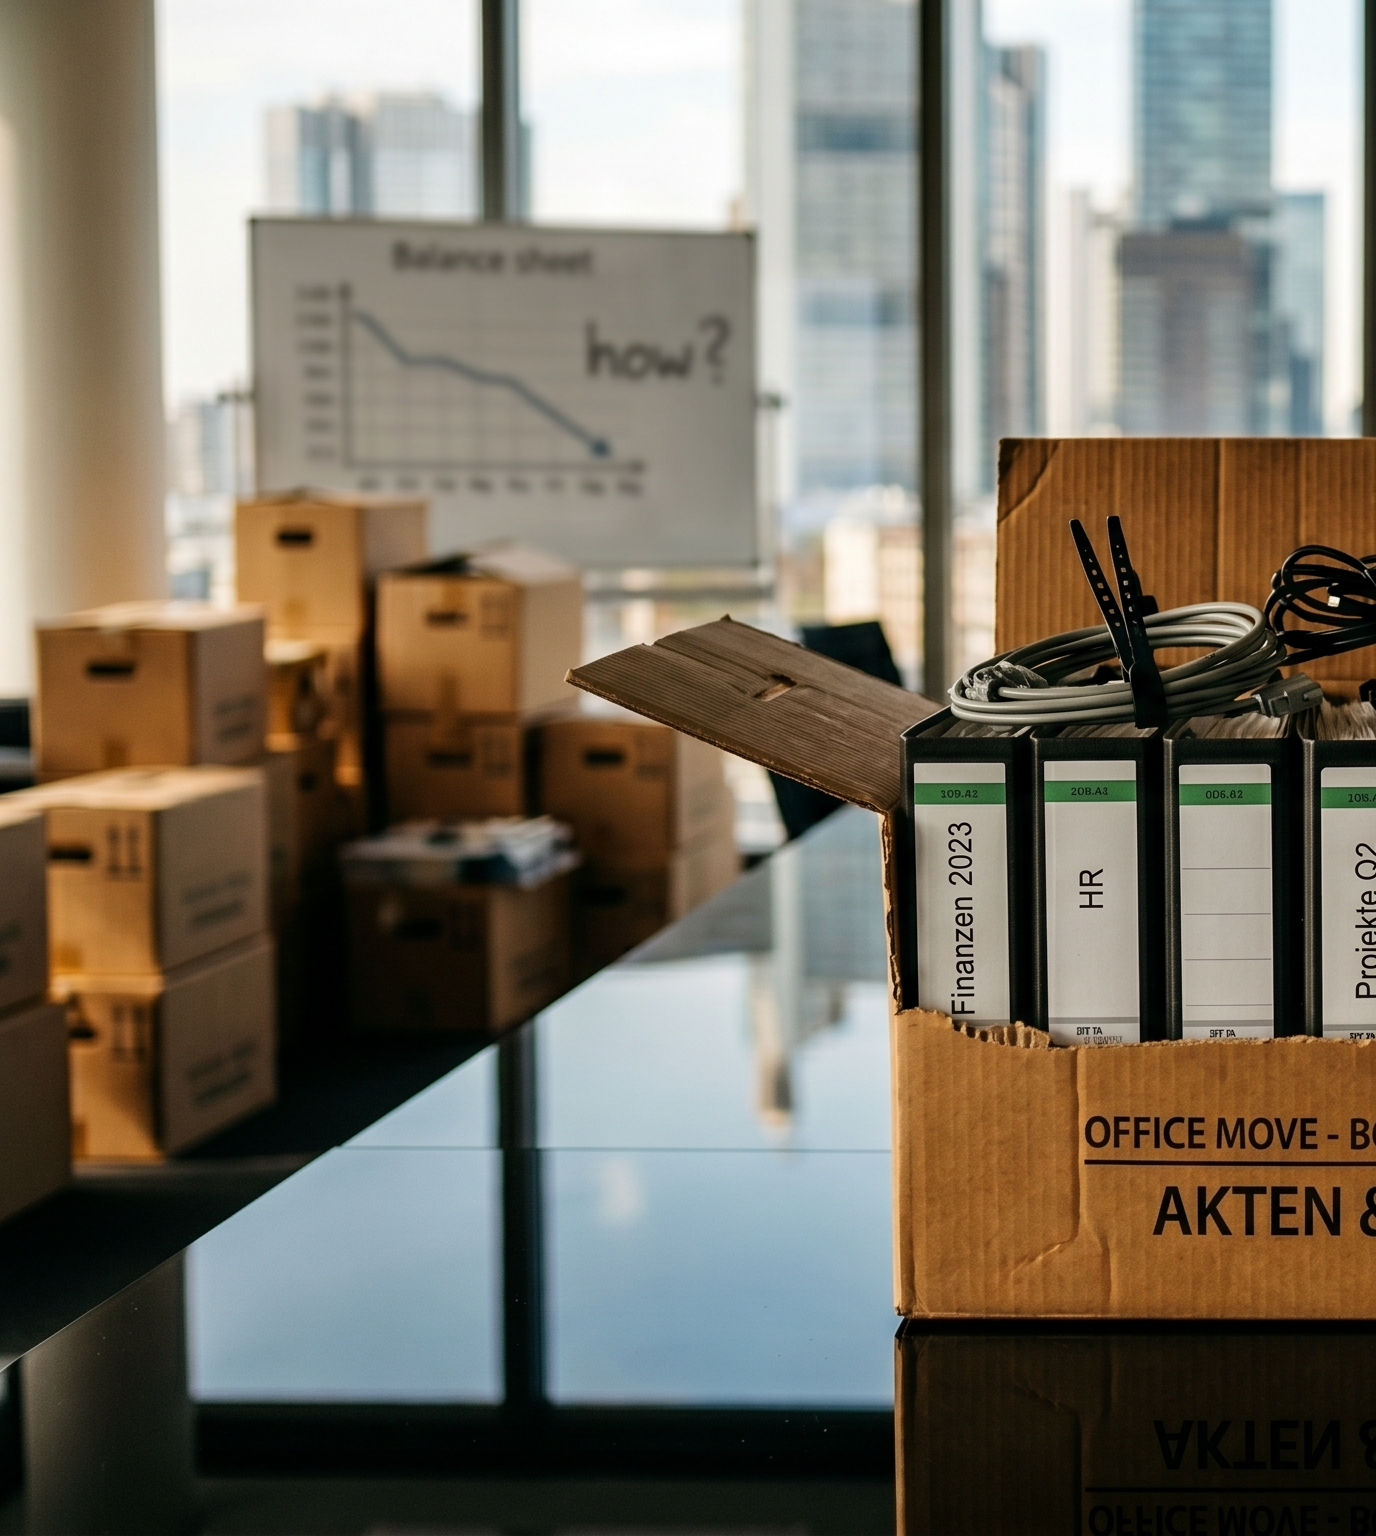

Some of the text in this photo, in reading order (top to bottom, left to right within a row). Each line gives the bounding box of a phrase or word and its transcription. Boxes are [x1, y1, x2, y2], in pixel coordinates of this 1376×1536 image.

[390, 240, 594, 275] Balance sheet
[586, 315, 733, 385] how?
[1079, 868, 1104, 909] HR
[947, 822, 975, 1015] Finanzen 2023
[1085, 1115, 1206, 1151] OFFICE
[1216, 1117, 1318, 1151] MOVE
[1153, 1185, 1341, 1237] AKTEN
